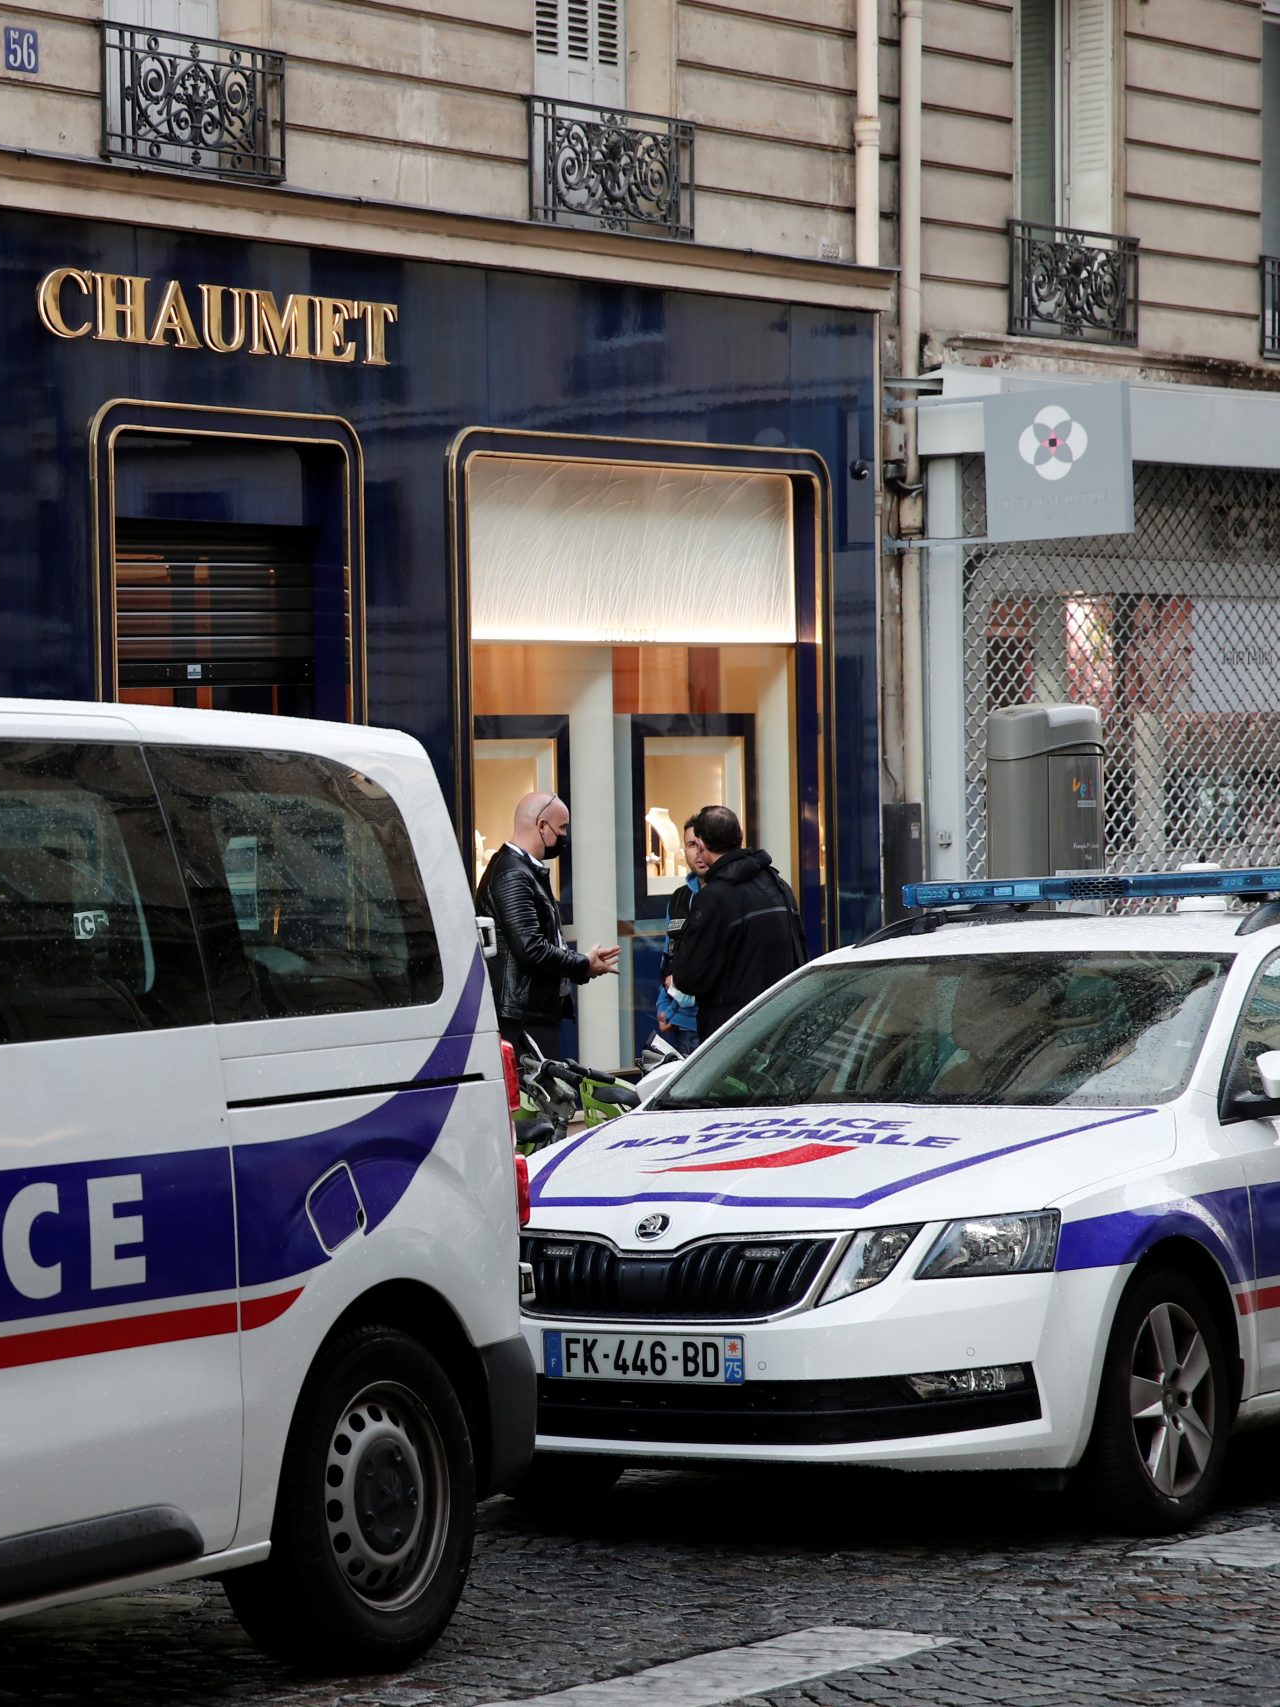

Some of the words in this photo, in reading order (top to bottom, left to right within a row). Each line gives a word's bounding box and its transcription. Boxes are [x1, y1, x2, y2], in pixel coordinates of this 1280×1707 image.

[9, 30, 36, 70] 56
[36, 266, 399, 366] CHAUMET
[697, 1117, 914, 1133] POLICE
[603, 1128, 963, 1150] NATIONALE
[551, 1358, 557, 1368] F
[565, 1337, 720, 1378] FK-446-BD
[725, 1361, 742, 1379] 75
